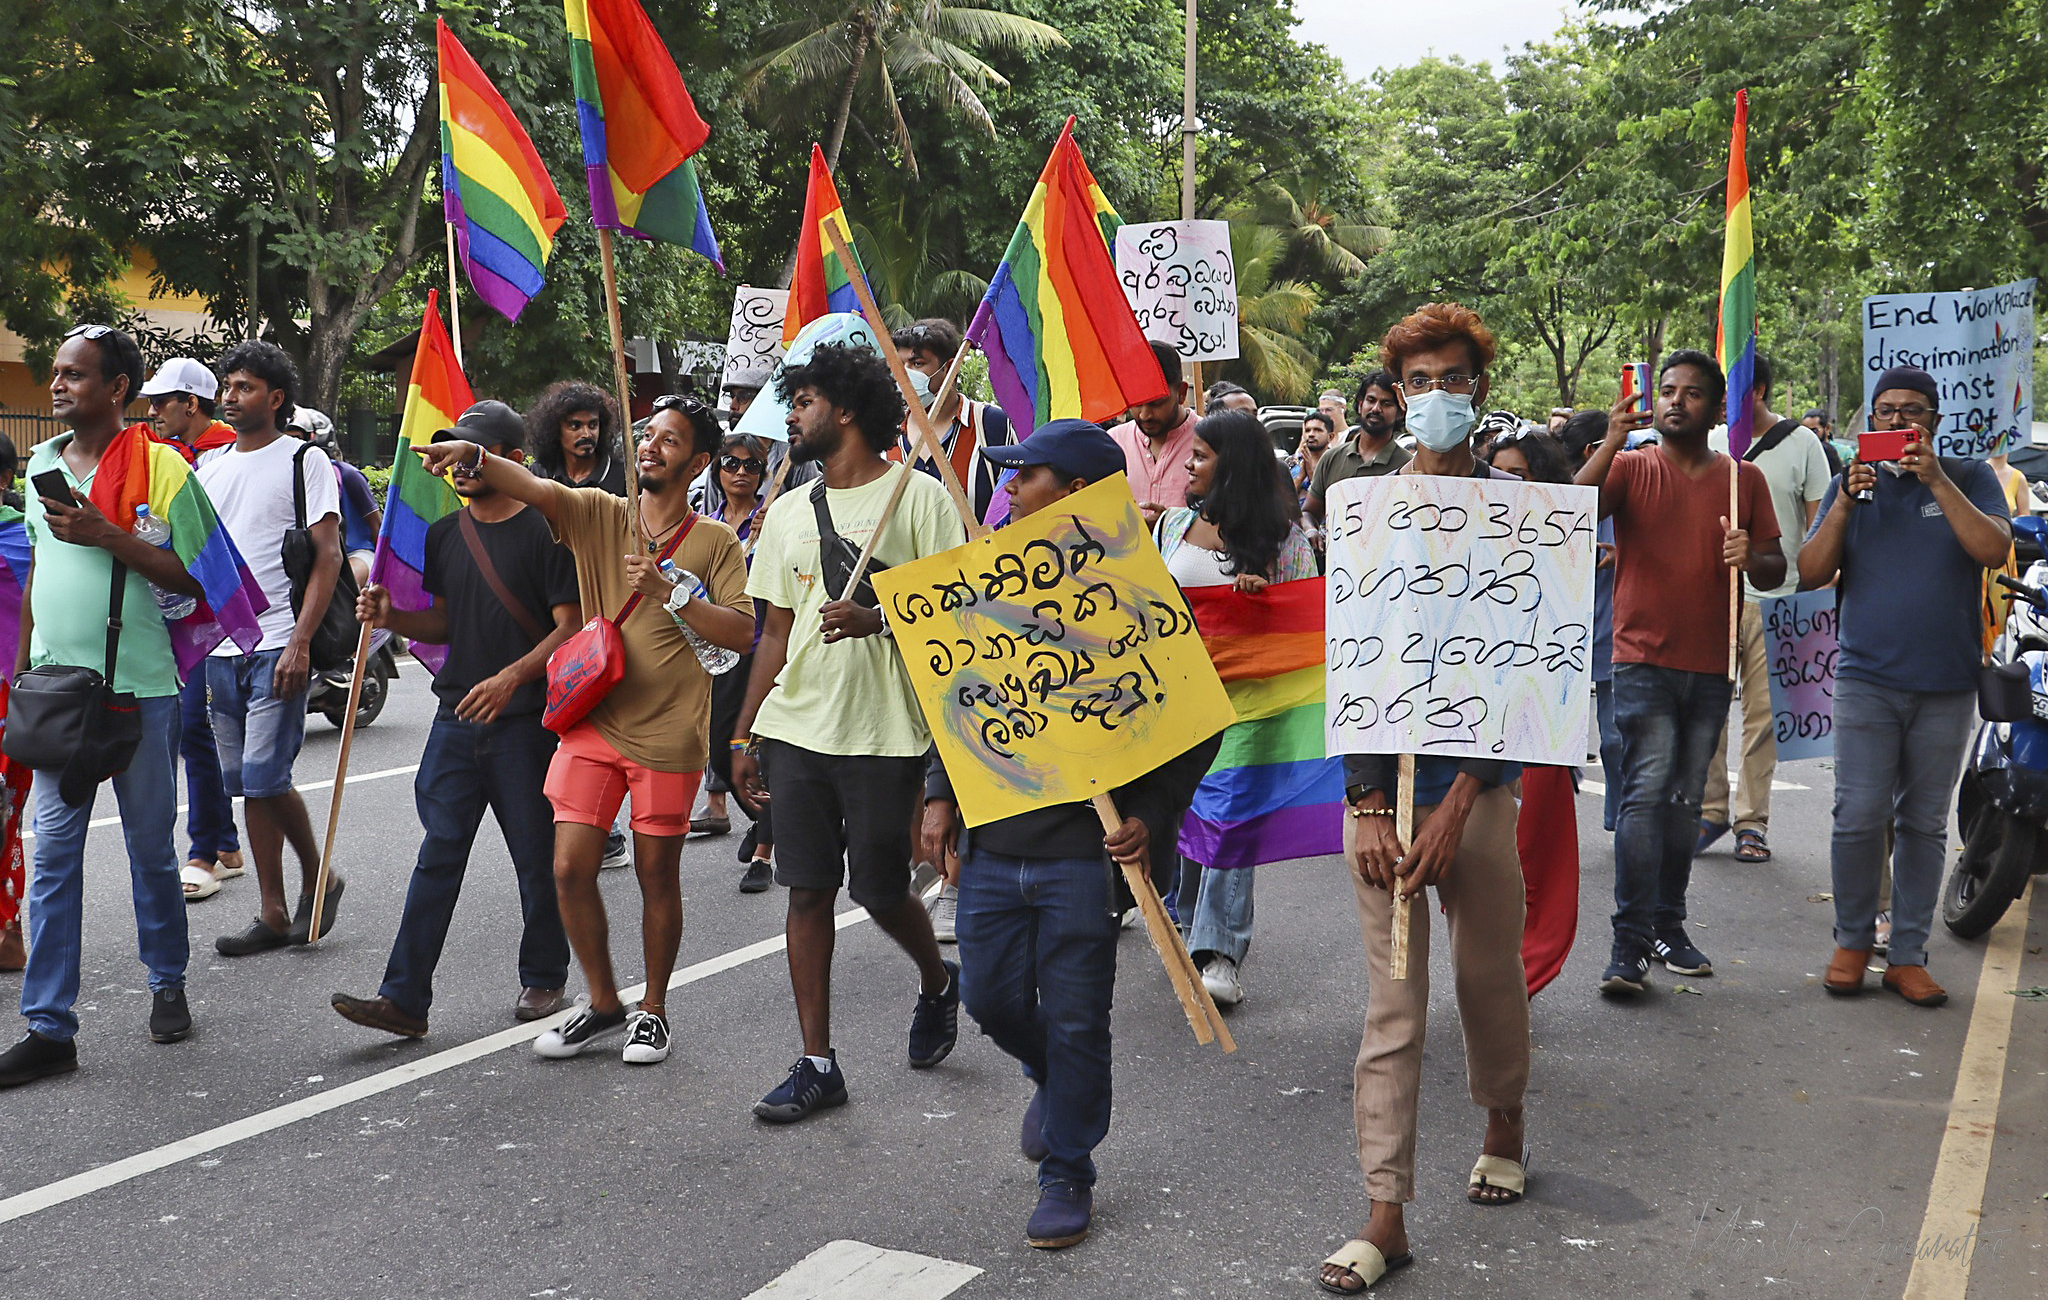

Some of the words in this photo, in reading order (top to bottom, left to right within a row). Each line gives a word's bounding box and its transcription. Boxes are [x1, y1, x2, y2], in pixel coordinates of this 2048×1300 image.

[1868, 296, 1939, 330] End
[1868, 337, 2019, 372] discrimination
[1937, 373, 1995, 400] inst
[893, 514, 1106, 625] ශක්තිමත්
[926, 582, 1117, 676] මානසික
